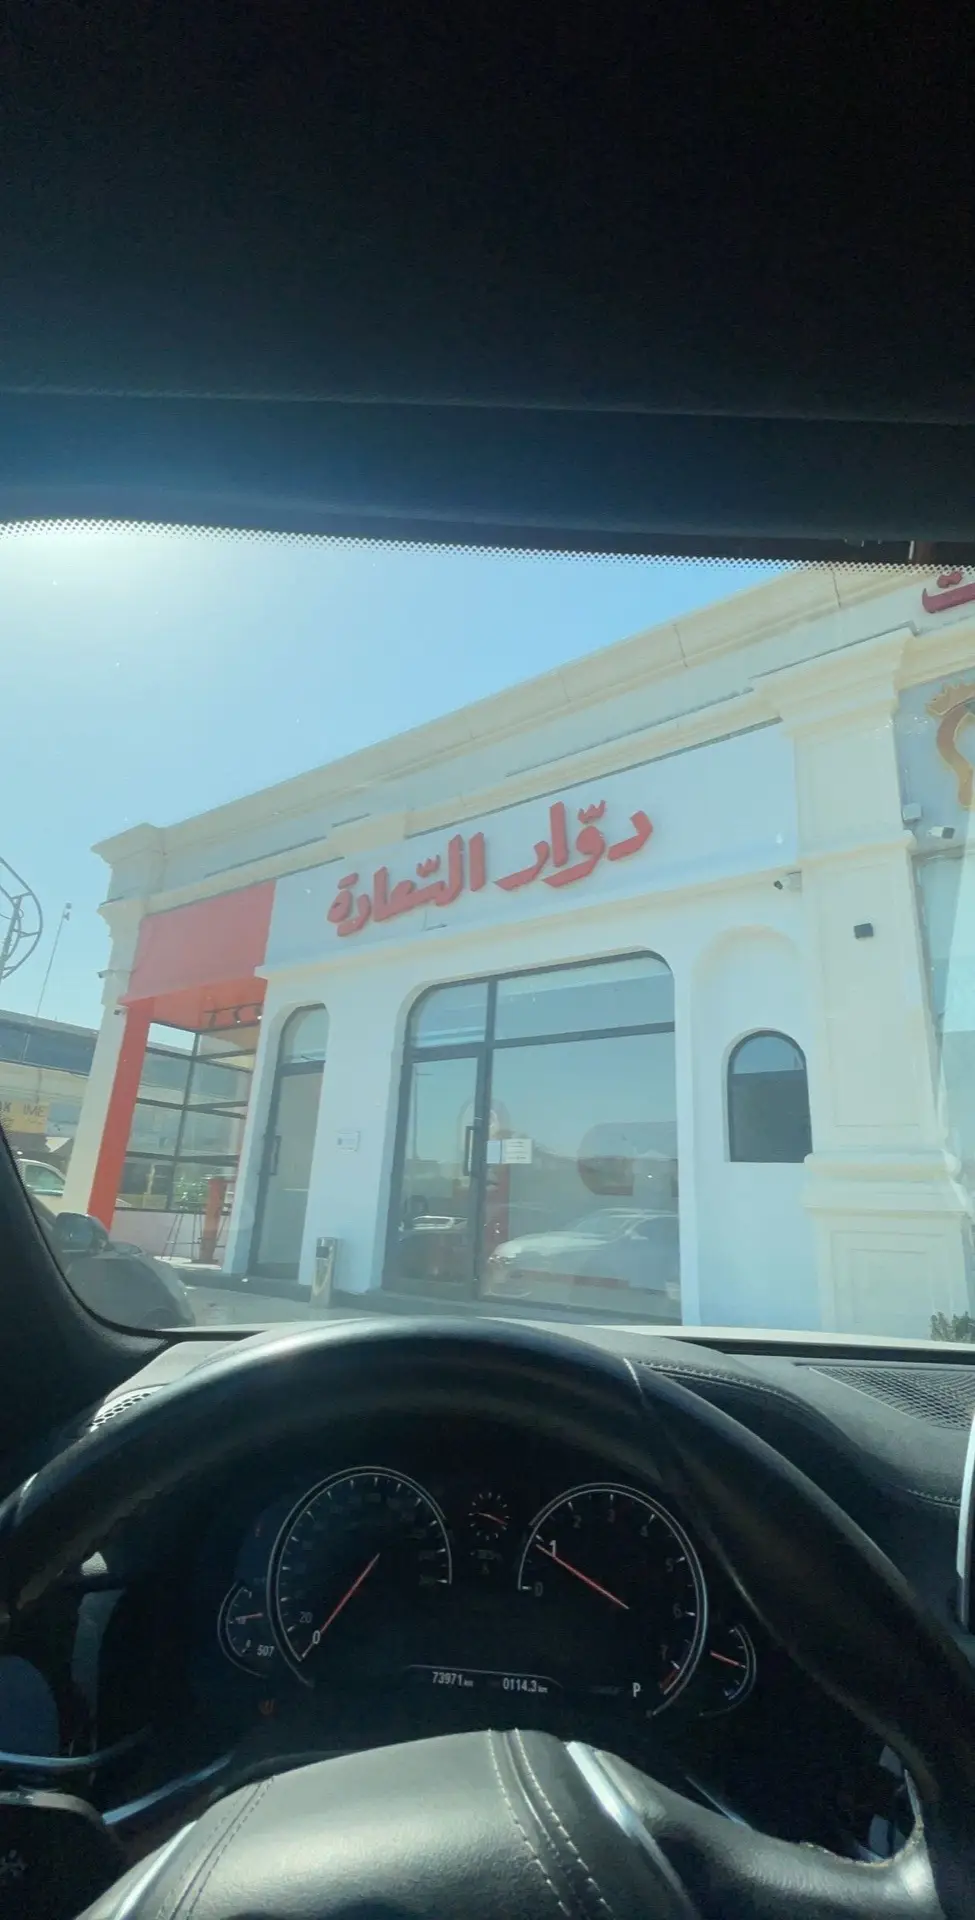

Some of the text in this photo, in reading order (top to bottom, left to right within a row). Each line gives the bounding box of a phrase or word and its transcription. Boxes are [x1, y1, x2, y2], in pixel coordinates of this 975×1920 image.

[549, 1539, 557, 1558] 1
[299, 1610, 314, 1624] 20
[312, 1629, 321, 1645] 0
[256, 1644, 275, 1658] 507
[432, 1671, 463, 1687] 73971
[503, 1677, 538, 1692] 0114.3
[632, 1682, 642, 1699] P
